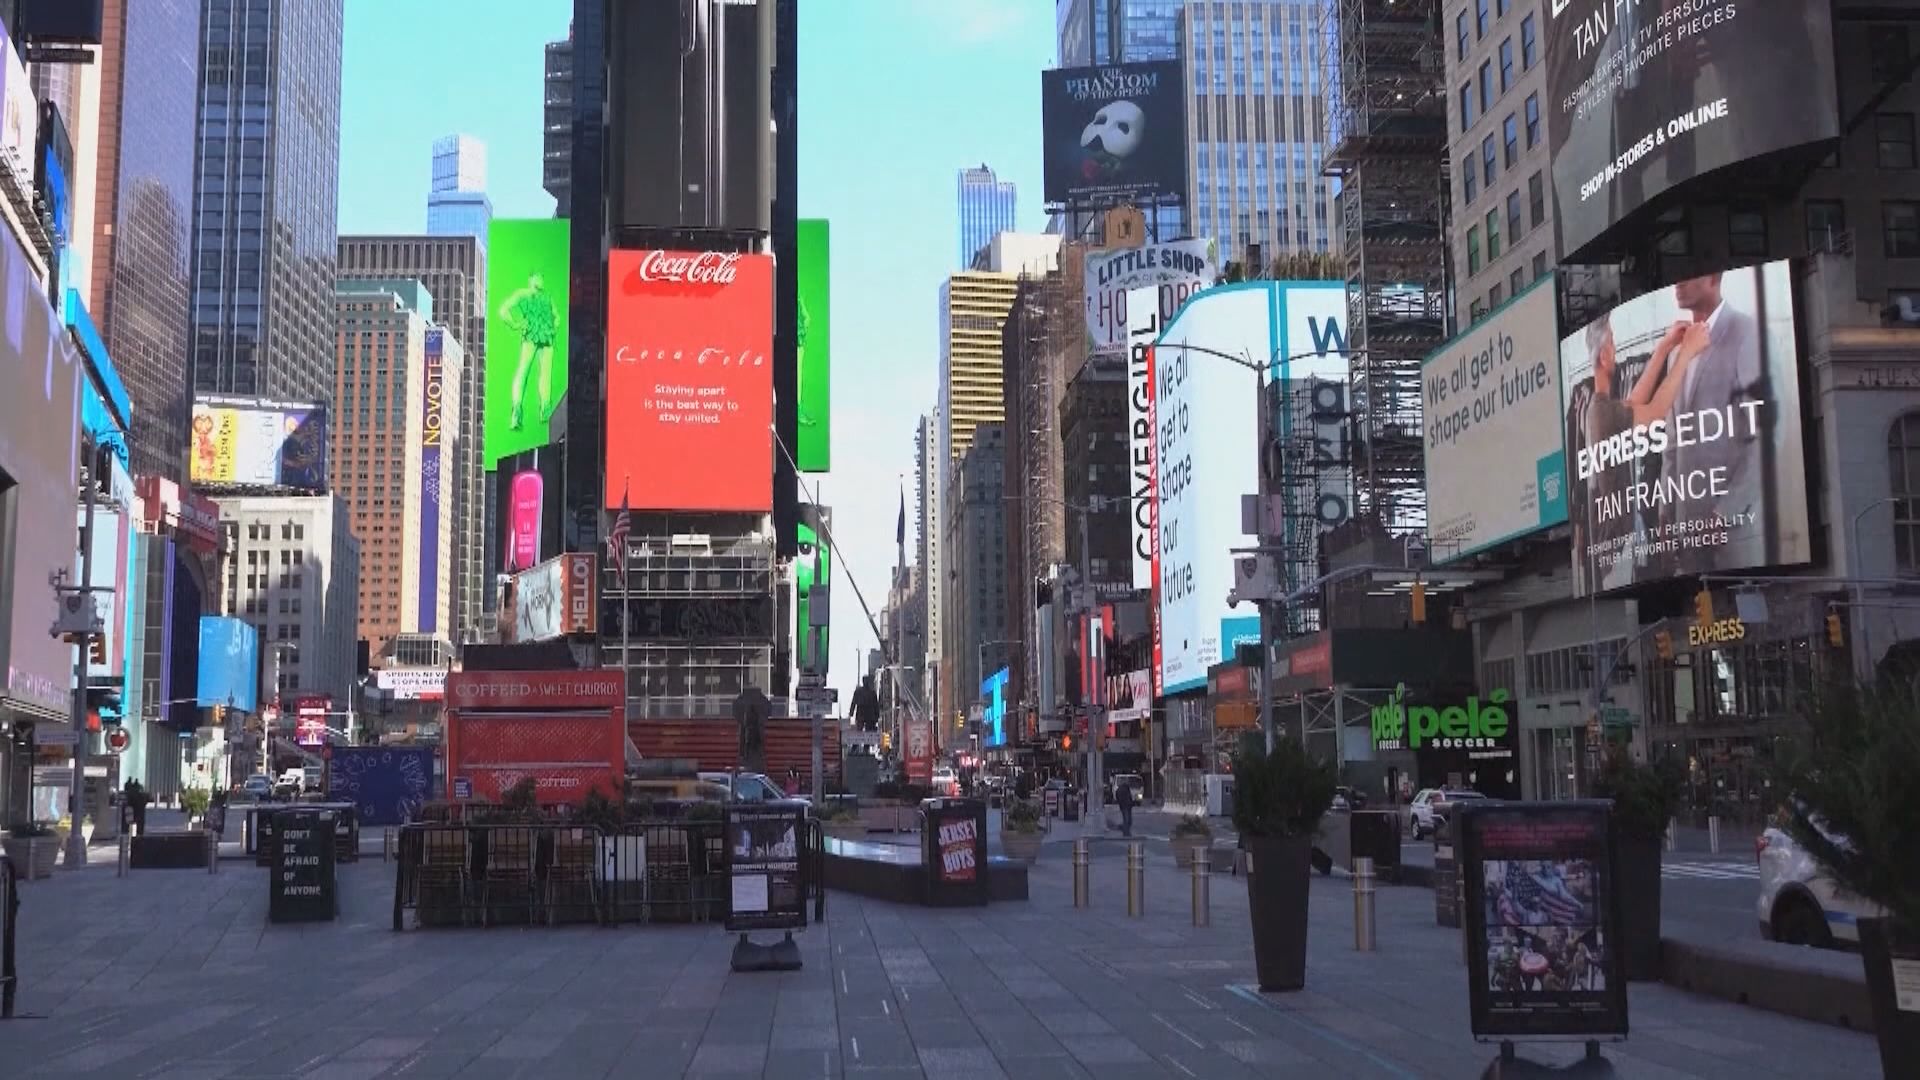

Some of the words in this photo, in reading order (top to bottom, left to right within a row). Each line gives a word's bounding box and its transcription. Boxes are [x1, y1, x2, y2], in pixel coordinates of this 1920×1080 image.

[1573, 3, 1608, 60] TAN
[1101, 67, 1122, 80] THE
[1563, 77, 1595, 113] FASHION
[1597, 44, 1628, 82] EXPERT
[1639, 24, 1652, 43] TV
[1577, 87, 1607, 119] STYLES
[1609, 70, 1623, 93] HIS
[1624, 32, 1673, 77] FAVORITE
[1677, 4, 1736, 42] PIECES
[1065, 71, 1158, 94] PHANTOM
[1113, 87, 1150, 98] OPERA
[1580, 170, 1604, 201] SHOP
[1605, 133, 1654, 184] IN-STORES
[1656, 127, 1666, 146] &
[1667, 98, 1729, 138] ONLINE
[639, 248, 743, 284] Coca-Cola
[1098, 248, 1157, 286] LITTLE
[1161, 247, 1205, 277] SHOP
[1158, 360, 1174, 404] We
[1175, 336, 1188, 387] all
[1428, 374, 1447, 408] We
[1451, 355, 1467, 394] all
[1471, 338, 1494, 390] get
[1498, 331, 1513, 364] to
[645, 399, 653, 409] is
[656, 399, 673, 409] the
[676, 400, 700, 409] best
[702, 402, 724, 411] way
[727, 401, 739, 411] to
[654, 384, 694, 397] Staying
[697, 386, 725, 397] apart
[1429, 405, 1470, 448] shape
[1473, 388, 1497, 423] our
[1500, 361, 1551, 409] future.
[658, 412, 681, 423] stay
[685, 413, 721, 423] united.
[1160, 403, 1176, 465] get
[1178, 396, 1189, 438] to
[1577, 419, 1669, 481] EXPRESS
[1675, 400, 1765, 448] EDIT
[1161, 453, 1192, 505] shape
[1594, 489, 1623, 525] TAN
[1625, 466, 1729, 514] FRANCE
[1163, 518, 1178, 555] our
[1586, 539, 1612, 556] FASHION
[1612, 532, 1638, 550] EXPERT
[1649, 526, 1662, 538] TV
[1665, 512, 1757, 536] PERSONALITY
[1598, 551, 1622, 567] STYLES
[1634, 539, 1680, 558] FAVORITE
[1683, 532, 1729, 549] PIECES
[1164, 561, 1196, 607] future.
[1688, 617, 1745, 646] EXPRESS
[455, 683, 532, 698] COFFEED
[539, 682, 572, 697] SWEET
[573, 681, 618, 696] CHURROS
[1370, 682, 1405, 752] pelé
[1407, 687, 1510, 749] pelé
[1431, 737, 1496, 748] SOCCER
[283, 829, 311, 840] DON'T
[283, 843, 297, 854] BE
[938, 817, 978, 846] JERSEY
[283, 856, 320, 867] AFRAID
[283, 871, 297, 881] OF
[942, 847, 976, 874] BOYS
[283, 886, 321, 896] ANYONE
